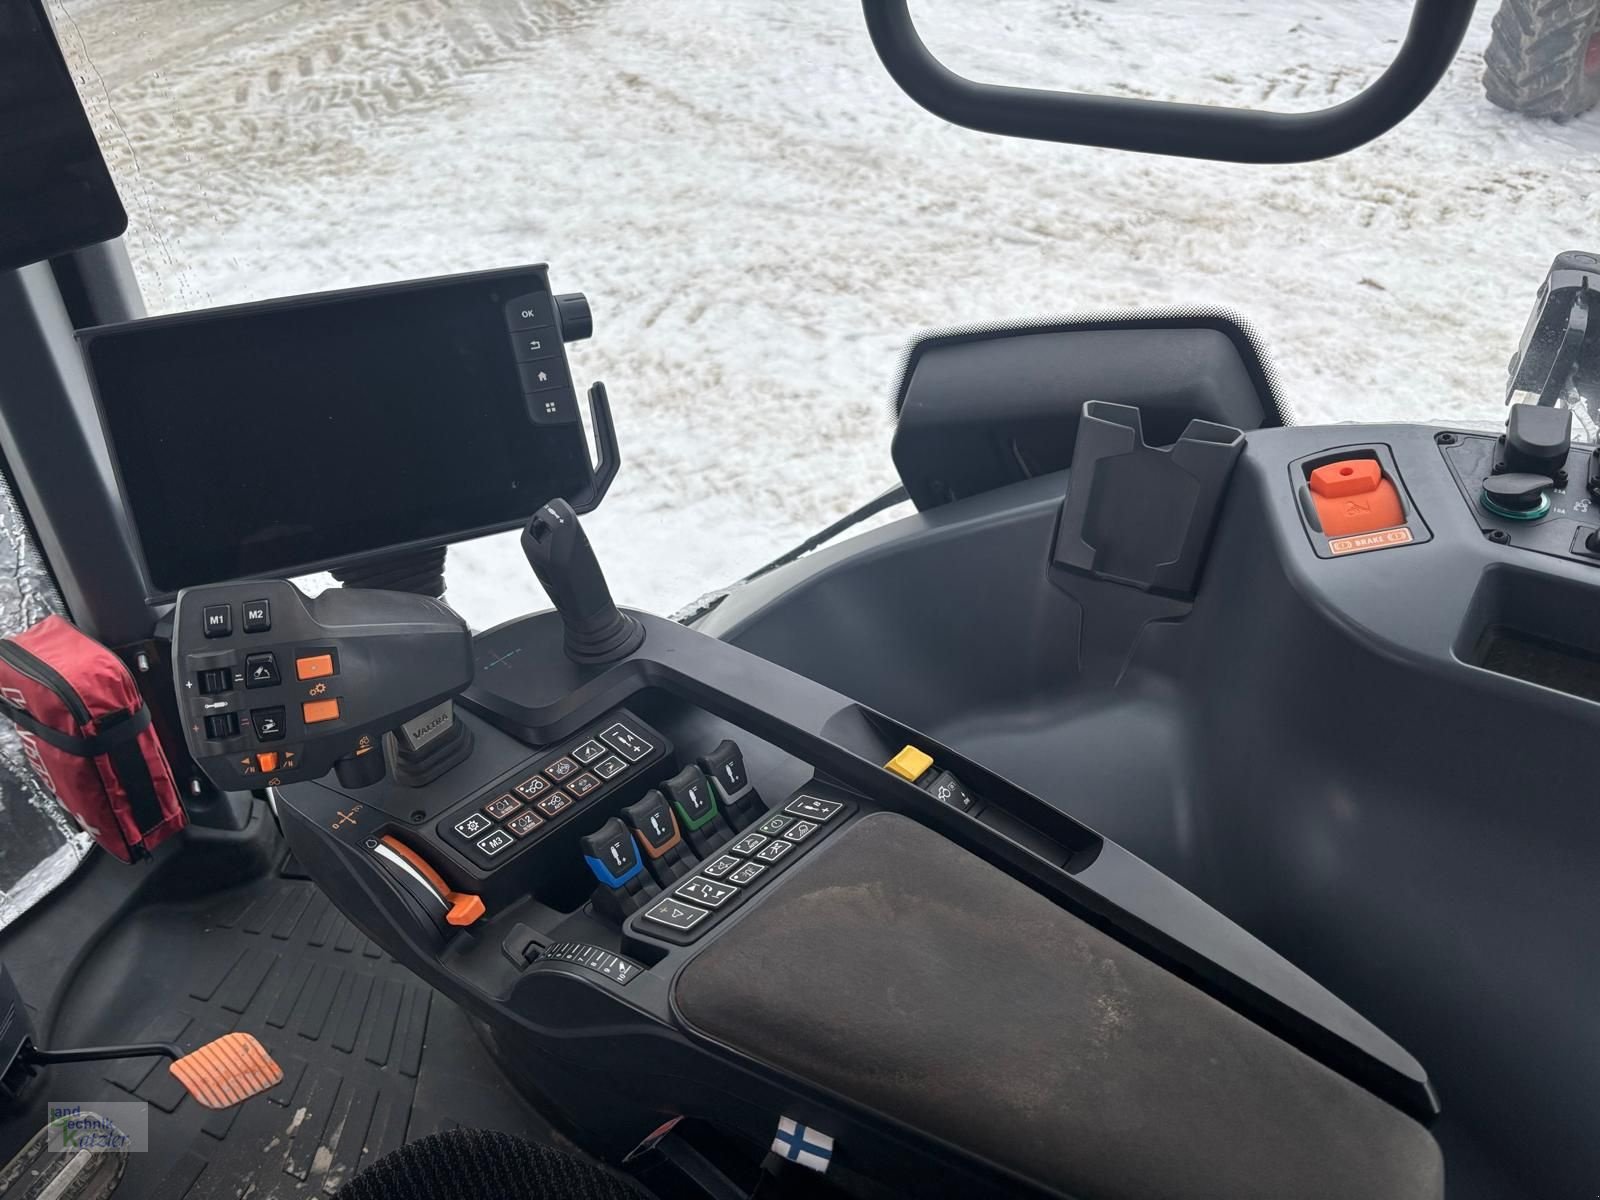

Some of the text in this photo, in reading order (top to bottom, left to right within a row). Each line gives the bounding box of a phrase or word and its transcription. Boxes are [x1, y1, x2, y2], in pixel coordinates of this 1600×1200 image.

[521, 309, 535, 319] OK
[1354, 536, 1385, 547] BRAKE
[248, 609, 265, 620] M2
[209, 615, 225, 625] M1
[412, 713, 449, 739] VALTRA
[524, 815, 533, 823] 2
[488, 836, 504, 849] M3
[616, 973, 627, 982] 10
